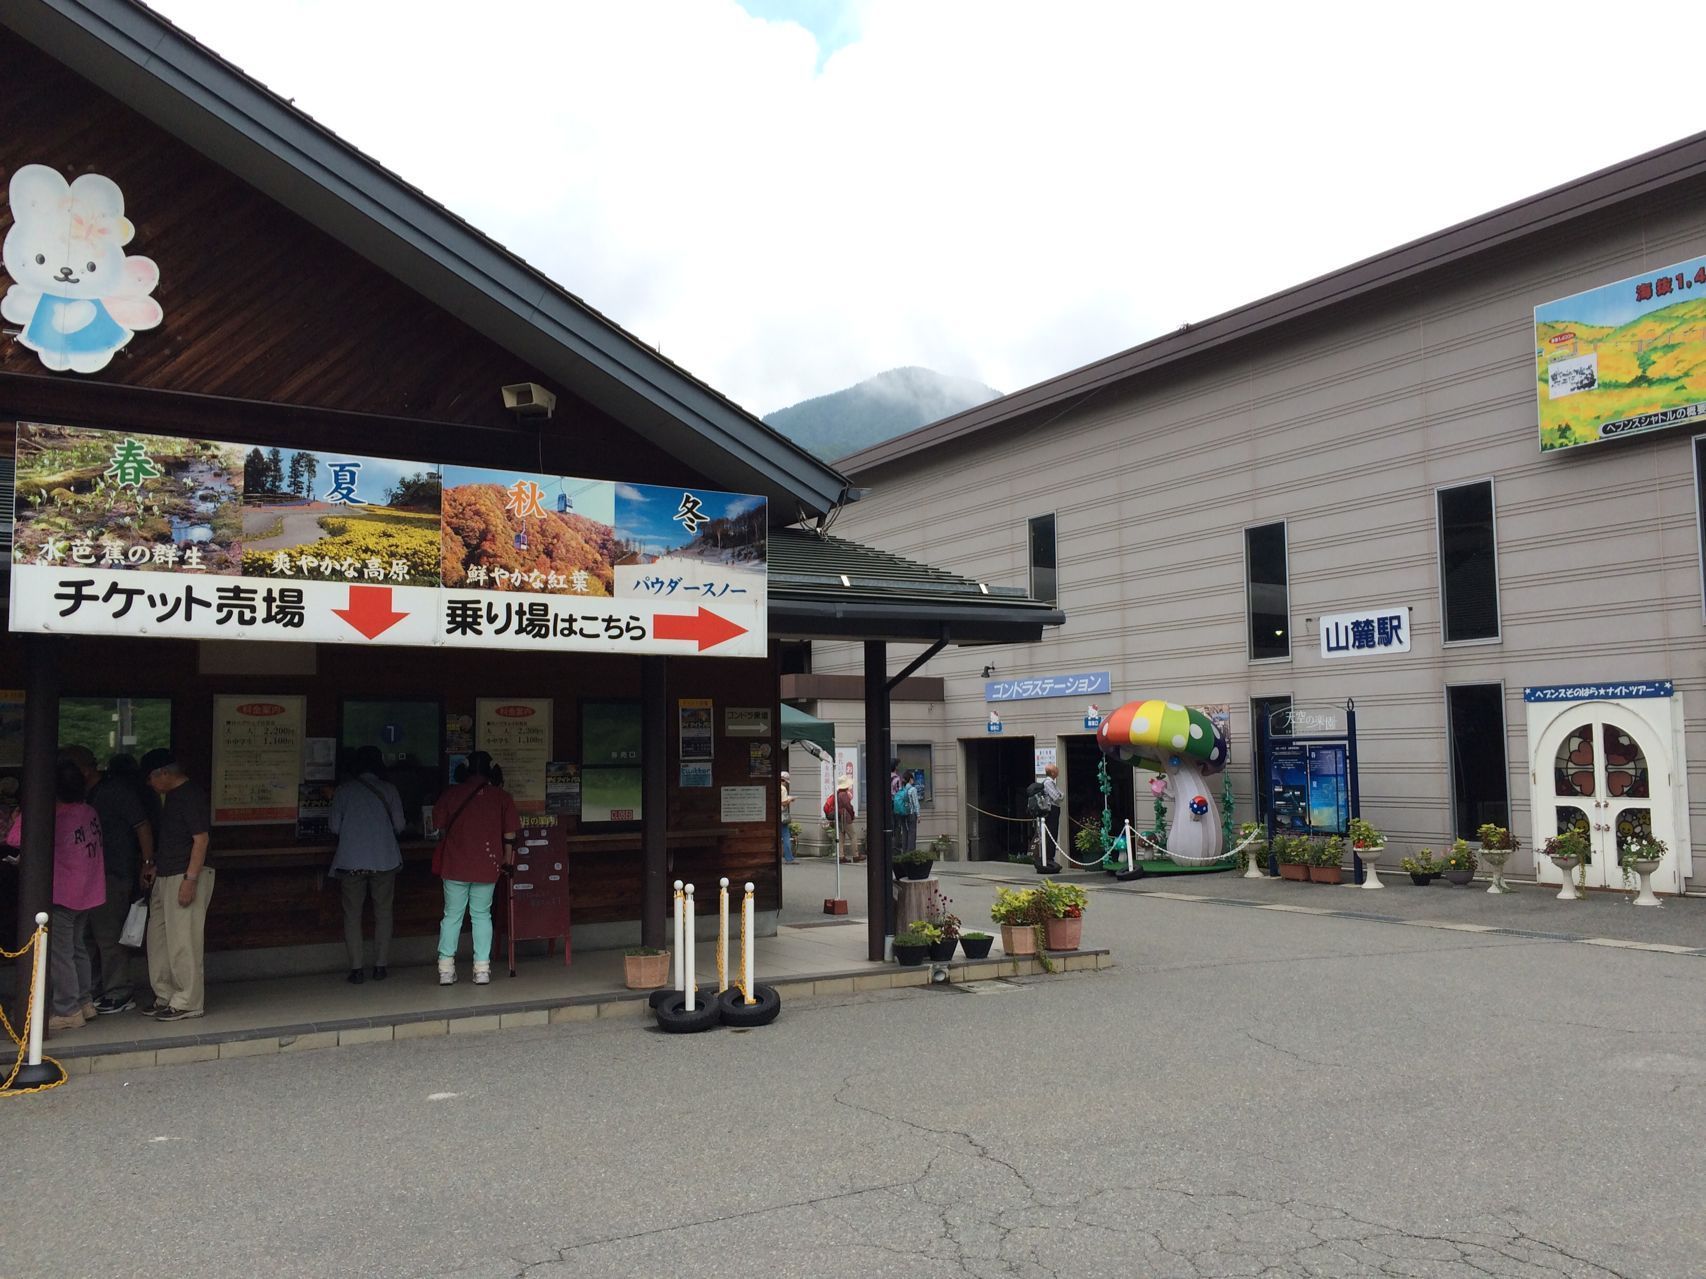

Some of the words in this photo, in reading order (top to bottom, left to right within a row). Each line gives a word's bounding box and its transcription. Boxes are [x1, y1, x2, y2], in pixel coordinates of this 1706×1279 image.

[105, 438, 160, 488] 春
[323, 461, 368, 505] 夏
[505, 480, 548, 519] 秋
[671, 492, 711, 535] 冬
[37, 537, 207, 570] 水芭蕉の群生
[271, 555, 411, 582] 爽やかな高原
[466, 564, 590, 593] 鮮やかな紅葉
[632, 576, 749, 597] パウダースノー
[53, 579, 307, 628] チケット売場
[445, 599, 647, 641] 乗り場はこちら
[1325, 614, 1404, 653] 山麓駅
[992, 676, 1101, 699] ゴンドラステーション
